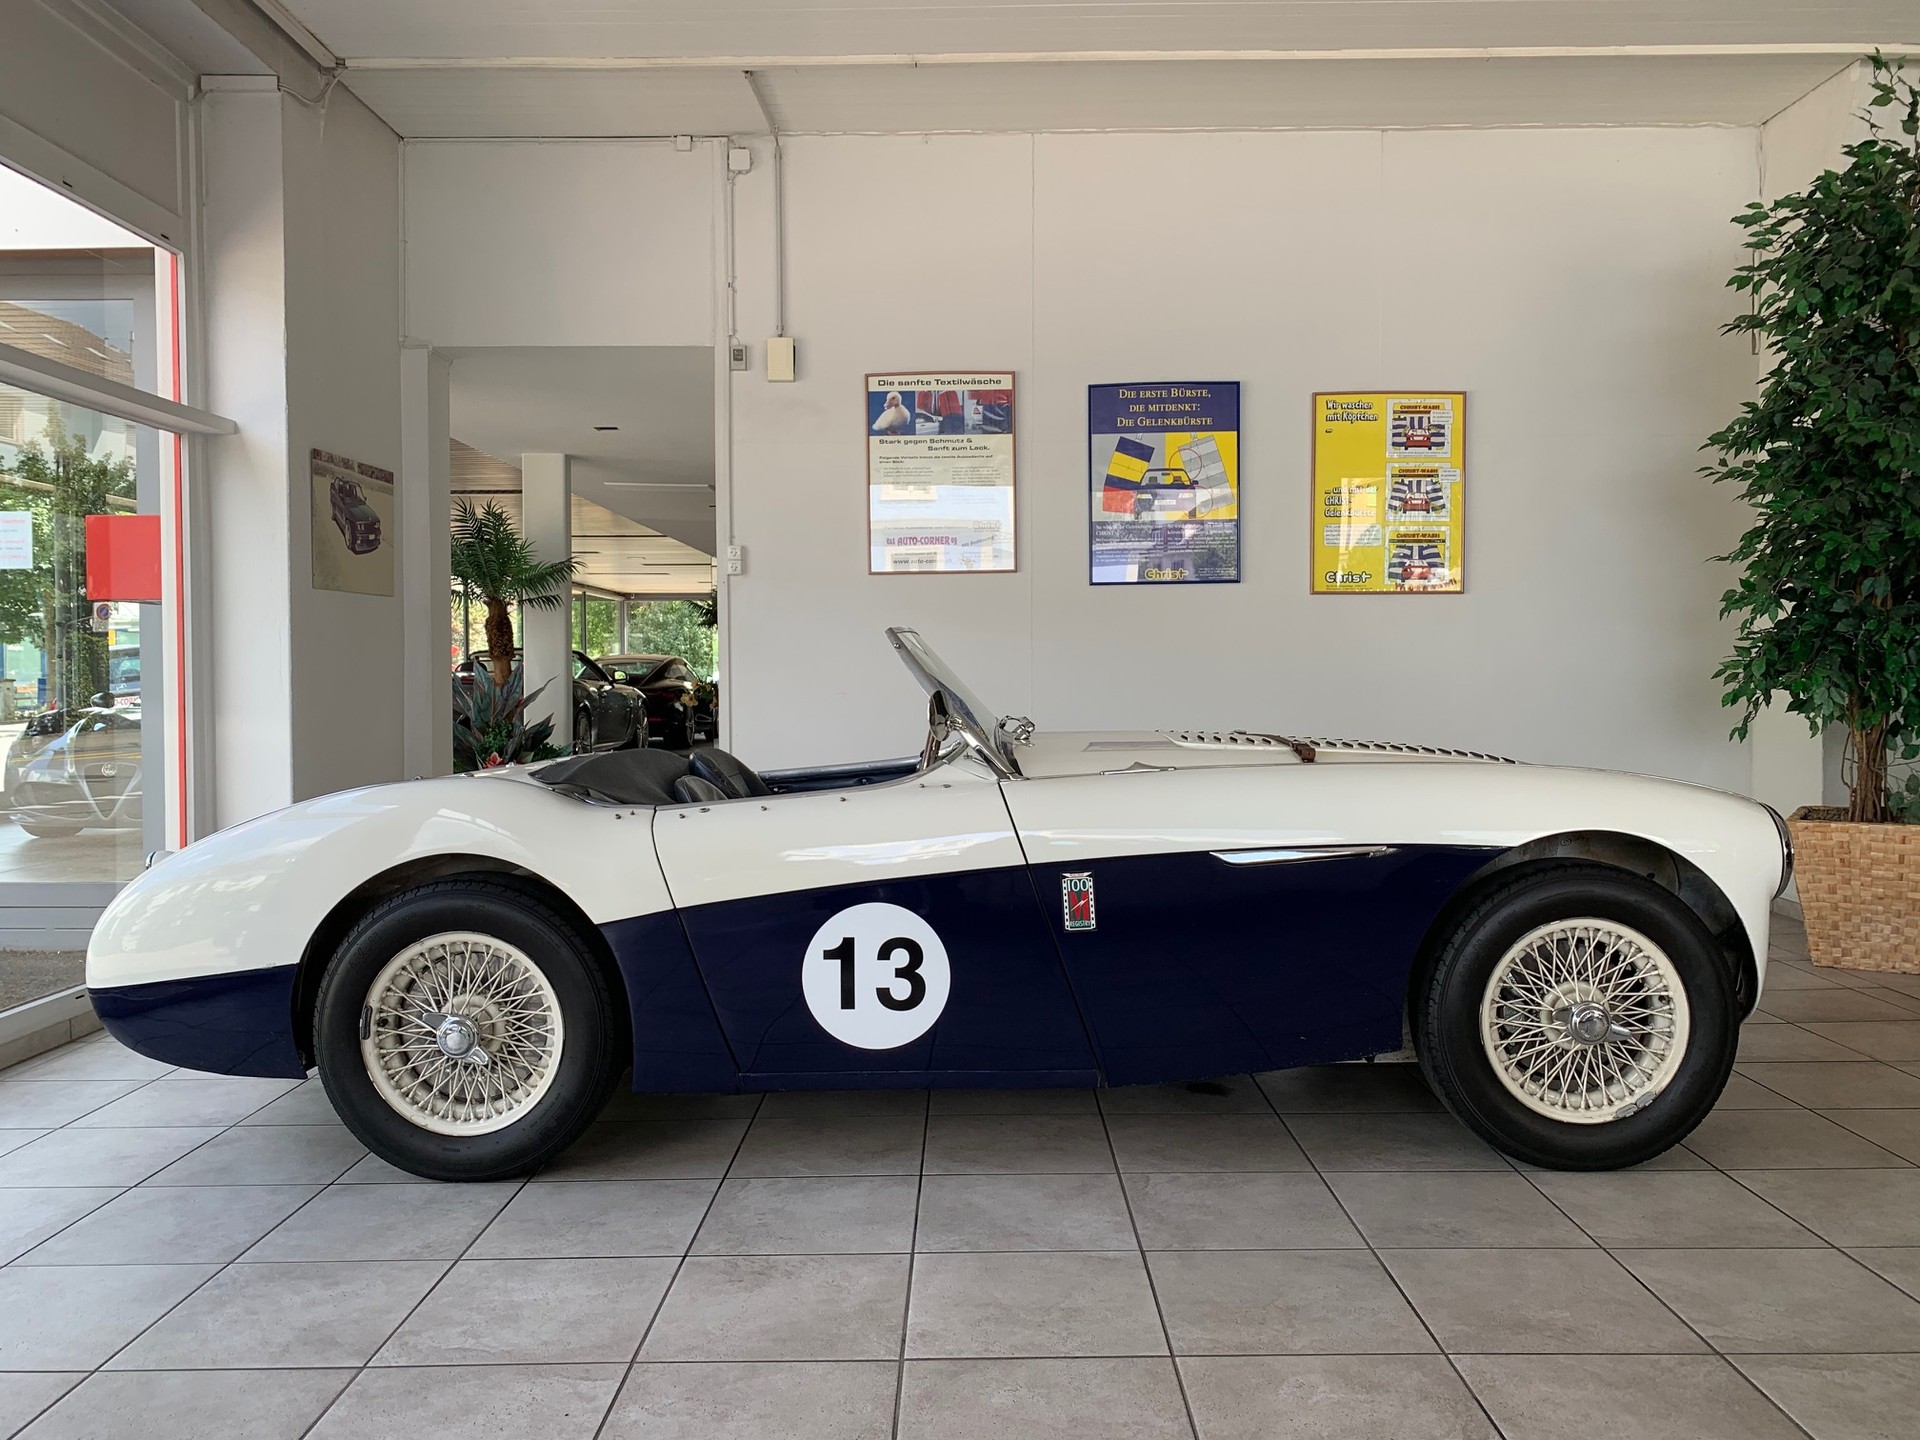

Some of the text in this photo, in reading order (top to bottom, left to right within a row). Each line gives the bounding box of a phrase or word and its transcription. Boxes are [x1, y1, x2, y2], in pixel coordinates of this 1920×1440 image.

[878, 377, 1002, 387] Die sanfte Textilwäsche
[1119, 387, 1211, 399] DIE ERSTE BÜRSTE,
[1148, 403, 1200, 412] MITDENKT:
[1325, 400, 1373, 410] Wir waschen
[1117, 416, 1213, 427] DIE GELENKBÜRSTE
[1325, 411, 1379, 424] mit Köpfchen
[903, 438, 928, 446] gegen
[897, 535, 950, 546] AUTO-CORNER
[1145, 568, 1189, 580] Christ
[1325, 570, 1372, 583] Christ
[1067, 879, 1089, 892] 100
[823, 936, 927, 1012] 13
